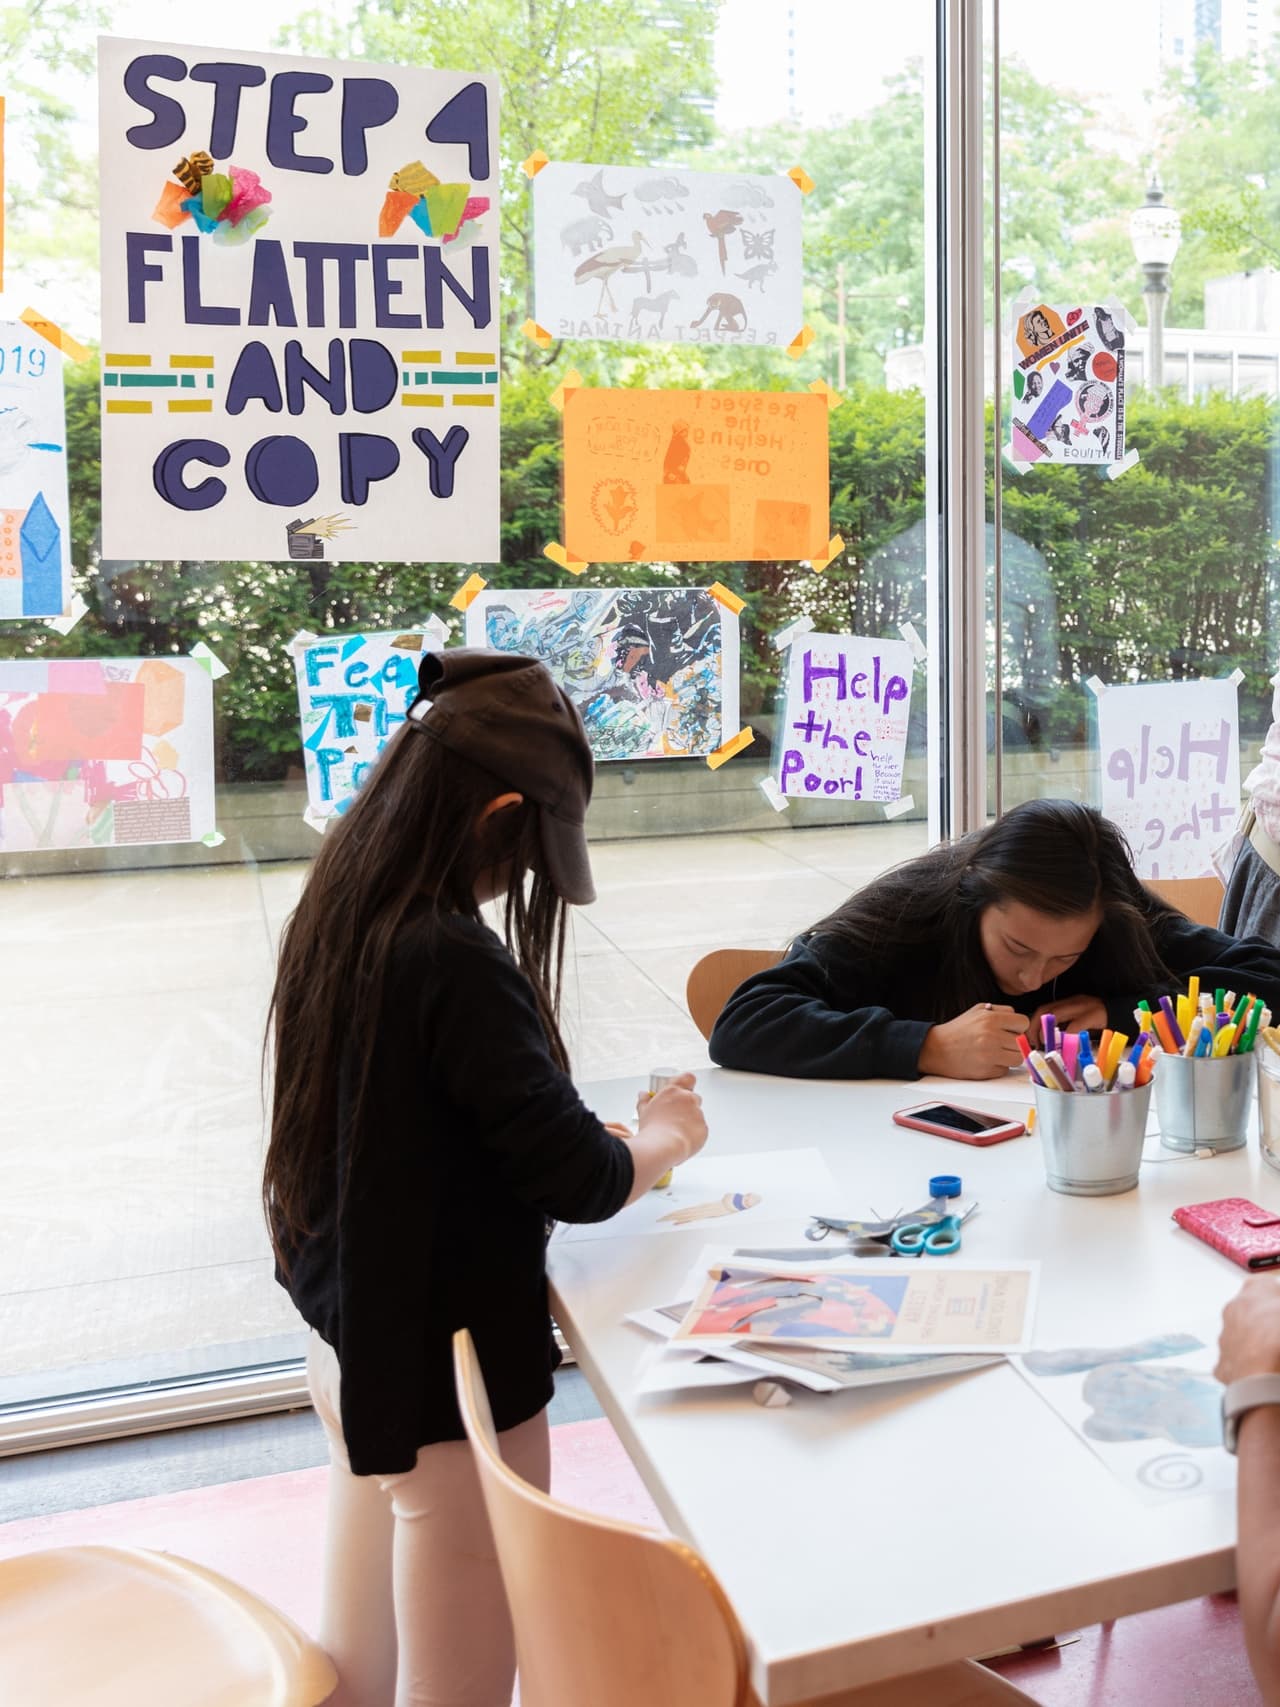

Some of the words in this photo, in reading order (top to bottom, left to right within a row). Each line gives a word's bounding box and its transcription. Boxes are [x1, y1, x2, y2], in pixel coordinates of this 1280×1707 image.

[124, 54, 400, 177] STEP
[425, 82, 490, 181] 4
[126, 231, 492, 329] FLATTEN
[225, 337, 399, 416] AND
[1018, 340, 1058, 370] WOMEN
[1055, 319, 1090, 348] UNITE
[153, 424, 470, 512] COPY
[1063, 447, 1112, 459] EQUITY
[803, 649, 908, 715] Help
[793, 709, 872, 757] the
